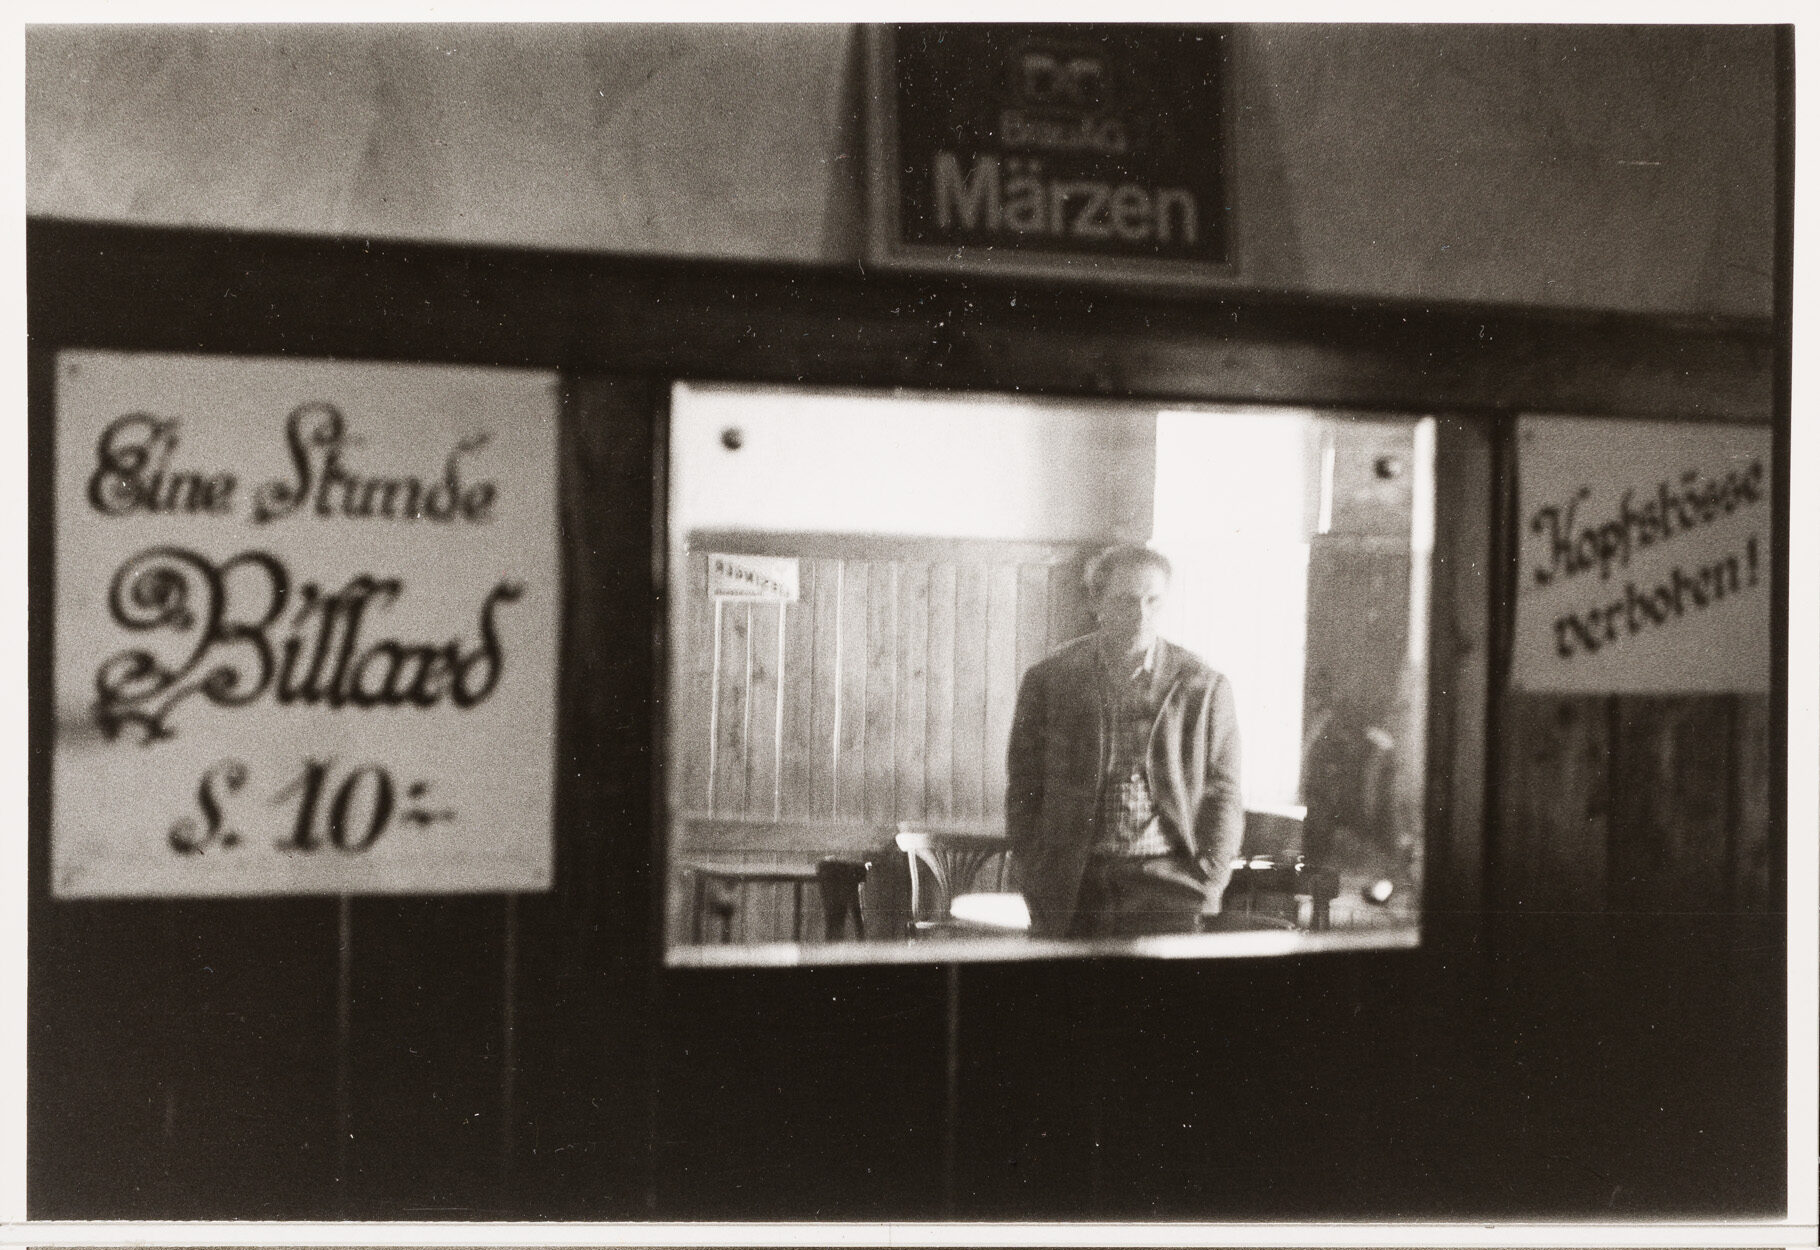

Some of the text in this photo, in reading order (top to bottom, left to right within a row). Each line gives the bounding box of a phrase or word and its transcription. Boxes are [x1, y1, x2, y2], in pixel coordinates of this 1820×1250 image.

[932, 150, 1199, 243] Märzen
[88, 401, 497, 525] Eine Stunde
[95, 546, 524, 745] Billard
